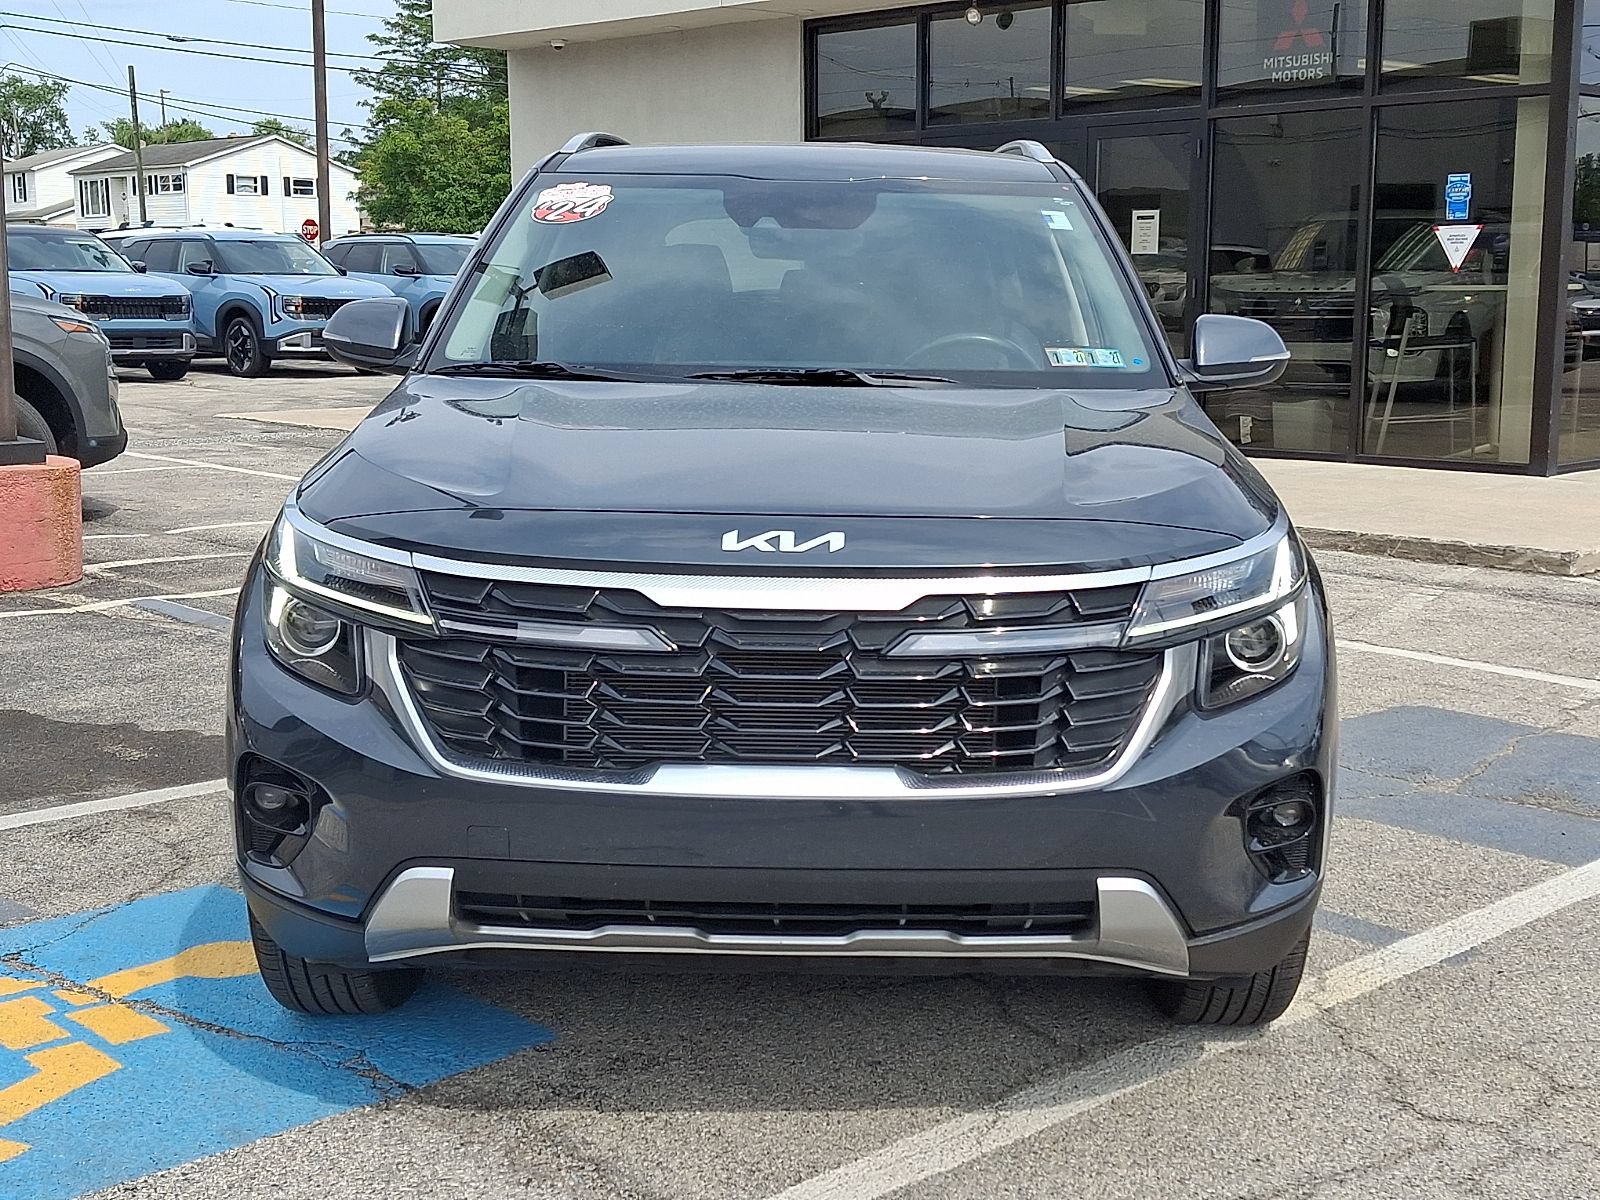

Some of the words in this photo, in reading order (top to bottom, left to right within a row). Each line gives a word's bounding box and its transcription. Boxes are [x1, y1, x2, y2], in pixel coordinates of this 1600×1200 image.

[1263, 52, 1333, 69] MITSUBISHI
[1271, 67, 1324, 83] MOTORS
[303, 226, 318, 235] STOP
[721, 529, 846, 553] KIA
